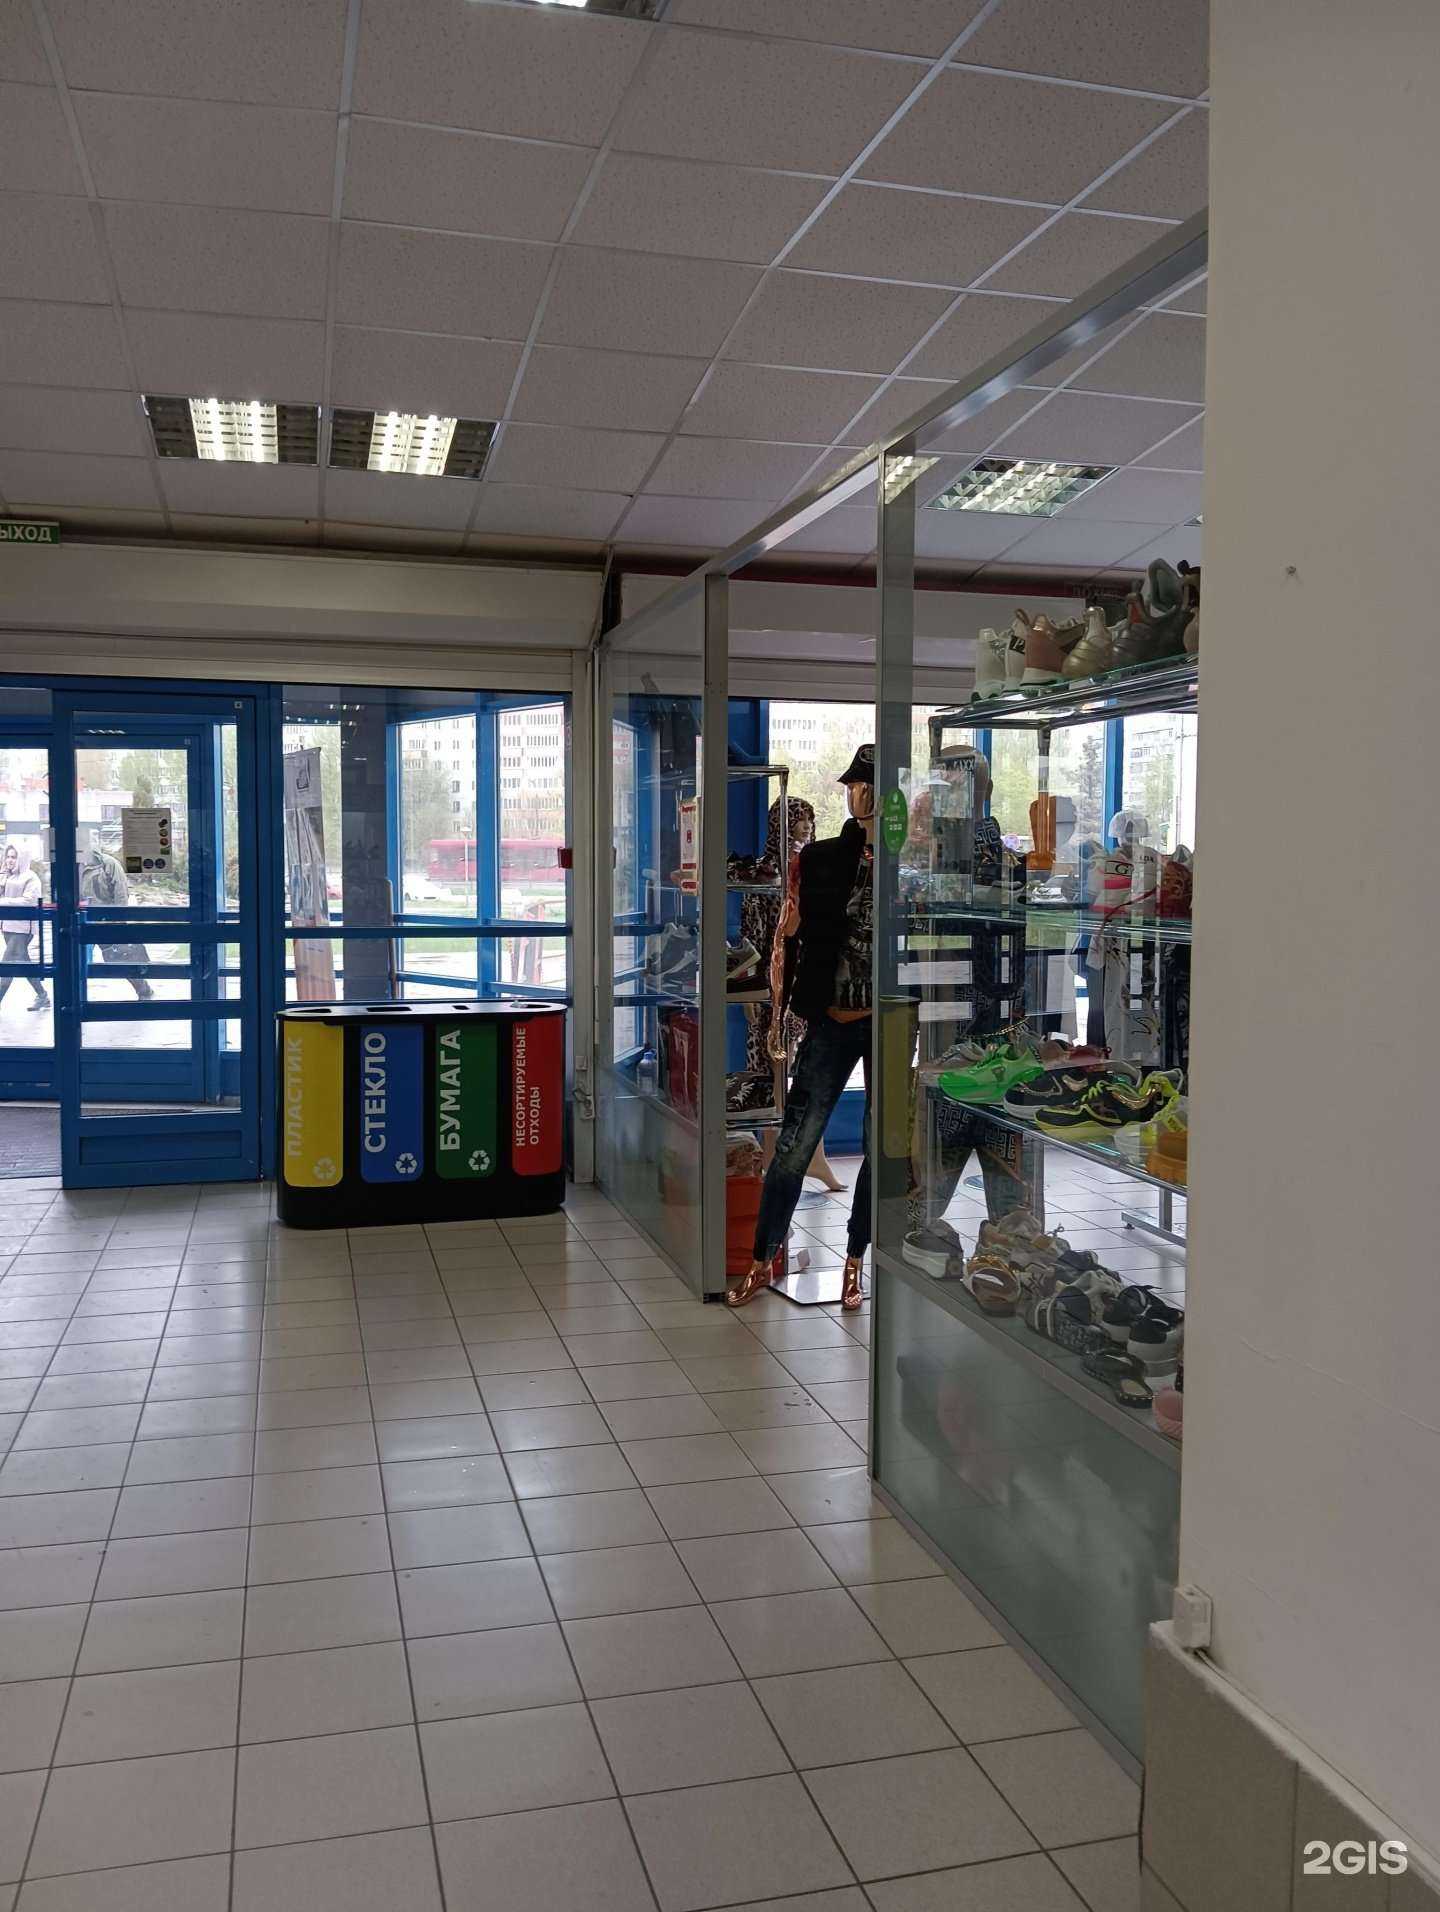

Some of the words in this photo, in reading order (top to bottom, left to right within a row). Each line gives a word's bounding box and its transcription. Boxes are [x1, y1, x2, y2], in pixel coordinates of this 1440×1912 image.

[288, 1036, 304, 1157] ПЛАСТИК
[364, 1032, 386, 1153] СТЕКЛО
[440, 1029, 461, 1151] БУМАГА
[515, 1027, 527, 1147] НЕСОРТИРУЕМЫЕ
[529, 1086, 541, 1145] ОТХОДЫ
